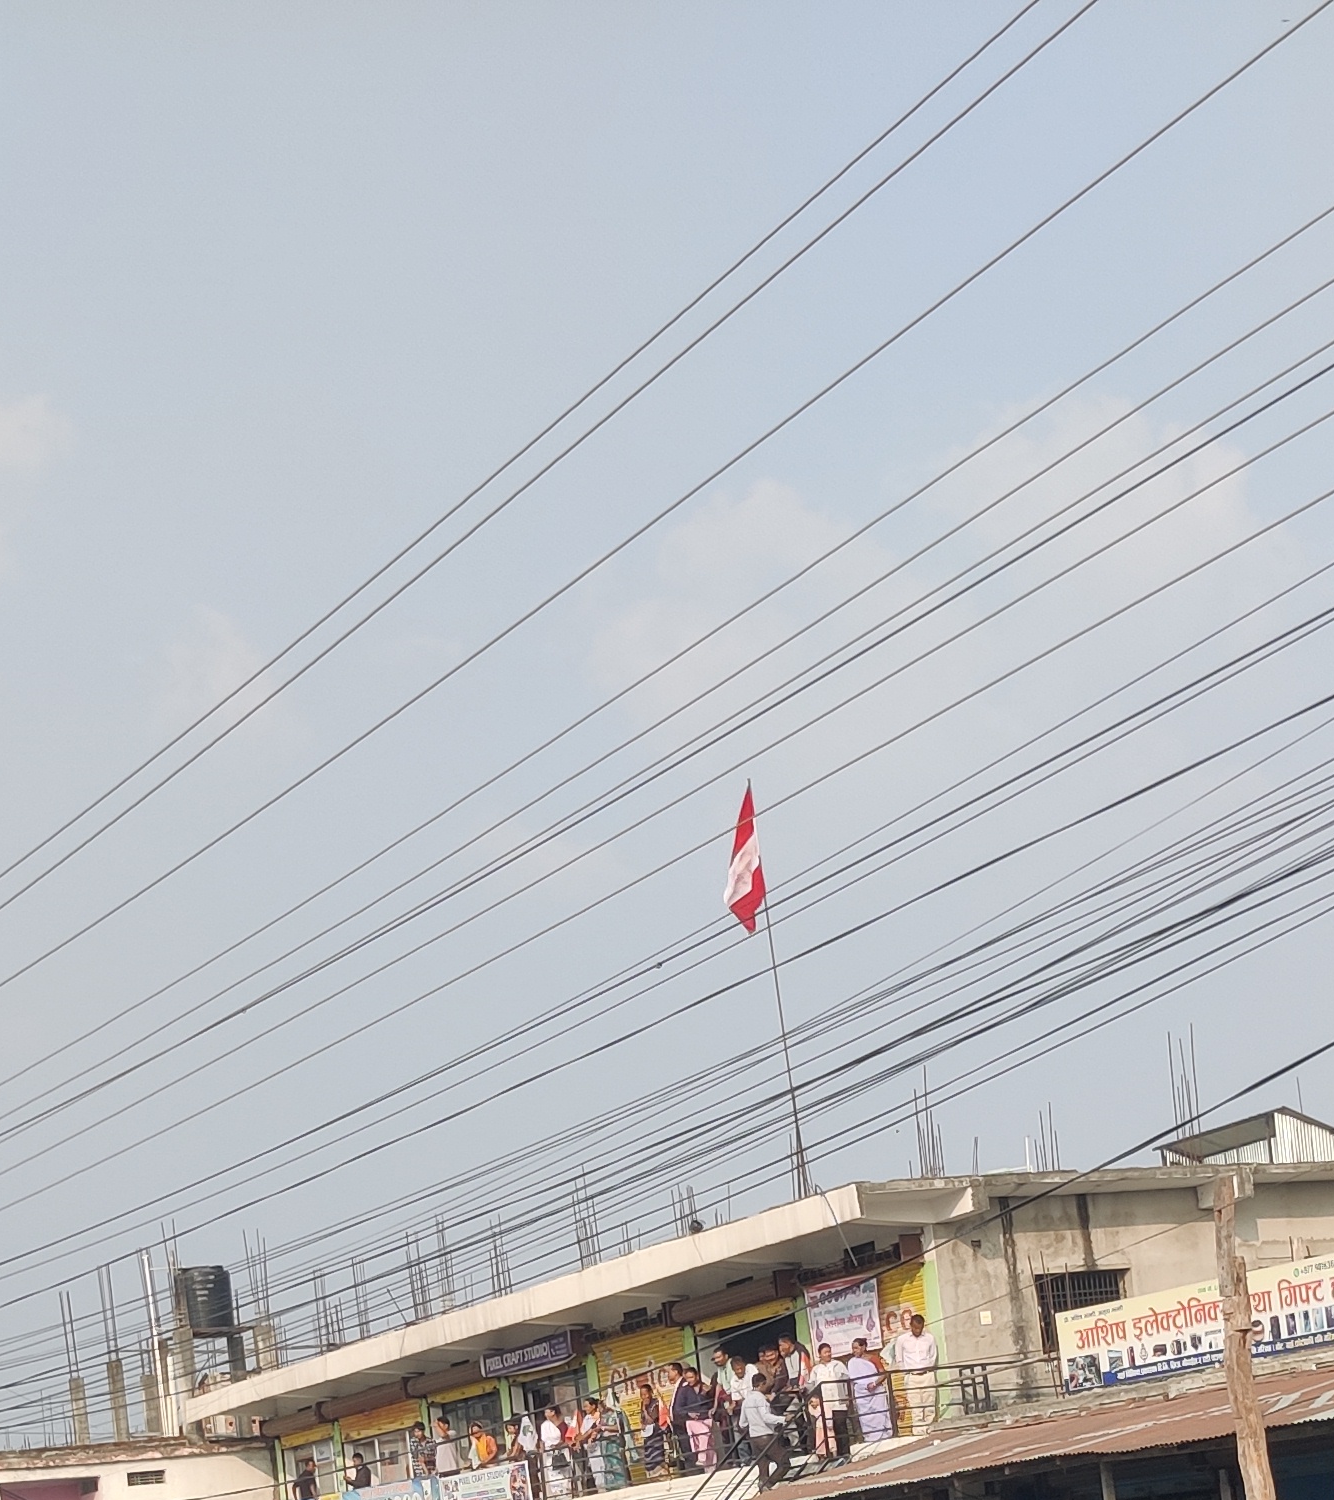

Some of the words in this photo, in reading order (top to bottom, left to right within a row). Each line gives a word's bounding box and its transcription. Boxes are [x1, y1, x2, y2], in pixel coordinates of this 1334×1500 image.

[1075, 1318, 1128, 1350] आशिष
[1132, 1297, 1224, 1341] इलेक्ट्रोनिक्
[1249, 1291, 1273, 1313] था
[1278, 1279, 1325, 1310] गिफ्ट
[486, 1355, 504, 1372] PIXEL
[504, 1350, 524, 1368] CRAFT
[524, 1343, 548, 1362] STUDIO
